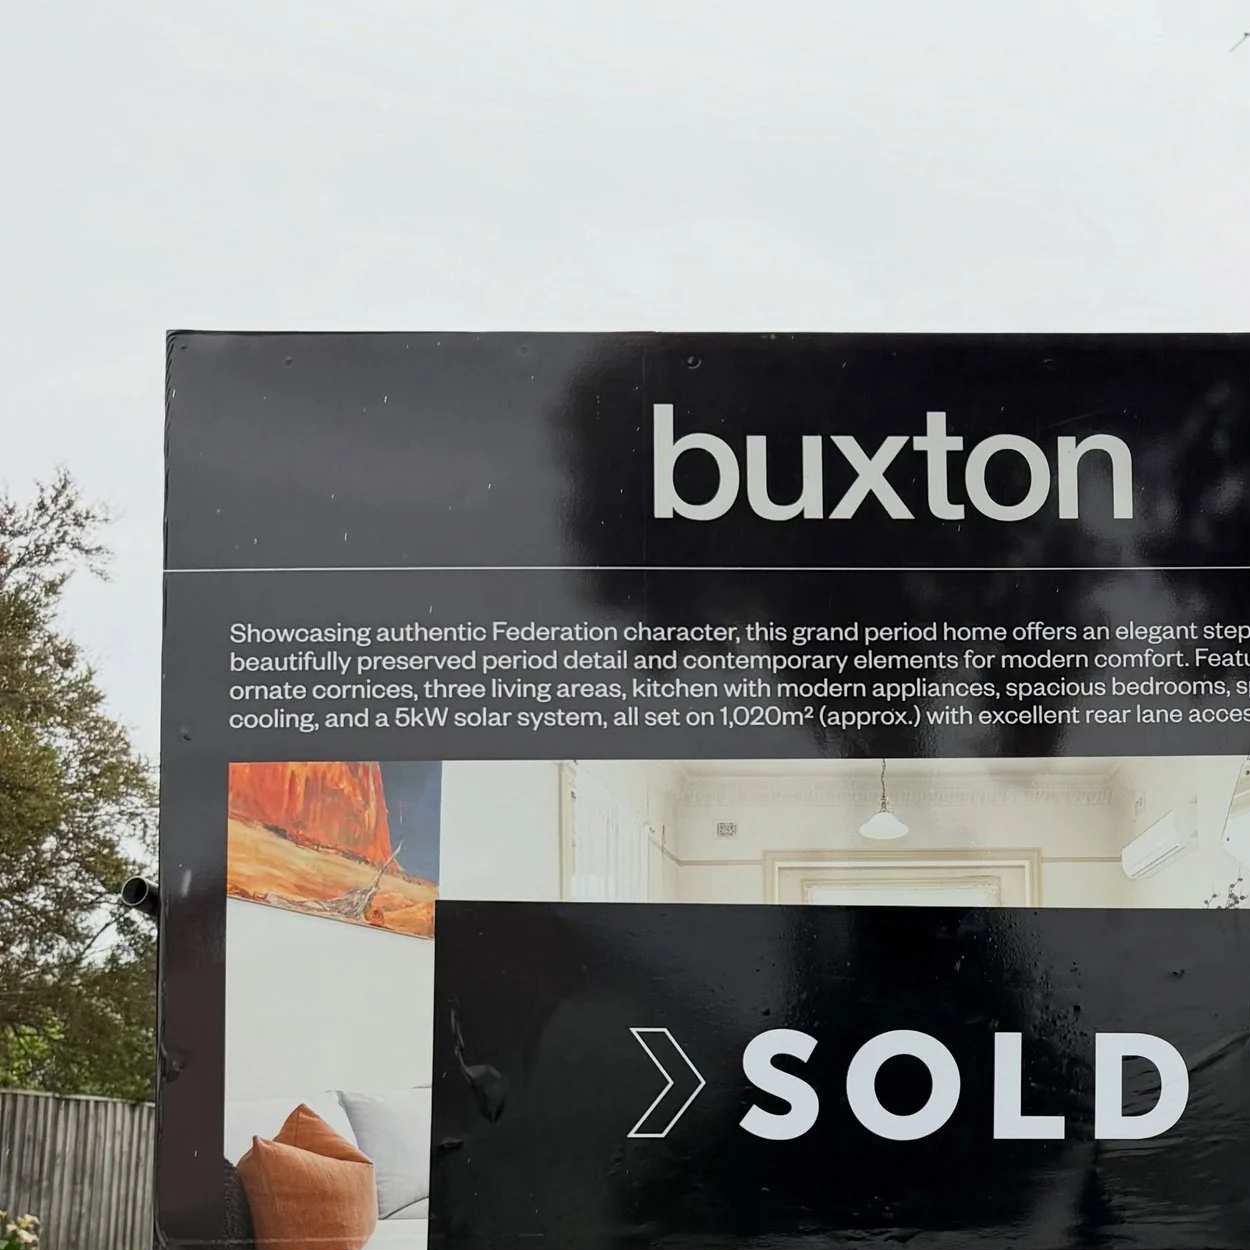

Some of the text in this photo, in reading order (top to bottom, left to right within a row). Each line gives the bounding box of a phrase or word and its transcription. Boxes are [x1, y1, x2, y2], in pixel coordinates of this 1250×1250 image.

[653, 403, 1133, 522] buxton
[229, 622, 372, 647] Showcasing
[375, 621, 487, 643] authentic
[492, 621, 618, 642] Federation
[623, 620, 741, 645] character,
[744, 621, 788, 642] this
[791, 621, 859, 647] grand
[864, 621, 938, 646] period
[943, 621, 1008, 642] home
[1012, 620, 1078, 641] offers
[1082, 625, 1110, 641] an
[1114, 620, 1199, 645] elegant
[230, 650, 353, 676] beautifully
[357, 649, 477, 676] preserved
[482, 649, 558, 675] period
[562, 649, 628, 670] detail
[633, 649, 678, 670] and
[682, 651, 849, 675] contemporary
[853, 649, 959, 670] elements
[962, 648, 997, 670] for
[1000, 648, 1089, 669] modern
[1093, 647, 1190, 669] comfort.
[229, 679, 307, 701] ornate
[311, 678, 419, 702] cornices,
[422, 678, 487, 699] three
[491, 677, 553, 703] living
[555, 682, 627, 701] areas,
[632, 677, 718, 698] kitchen
[722, 677, 771, 698] with
[776, 677, 867, 698] modern
[871, 677, 1001, 702] appliances,
[1005, 676, 1107, 702] spacious
[1111, 675, 1231, 698] bedrooms,
[228, 707, 320, 733] cooling,
[324, 707, 369, 728] and
[374, 712, 391, 728] a
[394, 706, 449, 728] 5kW
[453, 706, 513, 727] solar
[516, 708, 608, 732] system,
[613, 705, 639, 727] all
[644, 708, 681, 727] set
[685, 711, 715, 727] on
[719, 705, 815, 729] 1,020m²
[818, 704, 921, 731] (approx.)
[925, 704, 973, 725] with
[977, 704, 1081, 725] excellent
[1085, 708, 1132, 724] rear
[1136, 703, 1183, 724] lane
[739, 1028, 1189, 1141] SOLD
